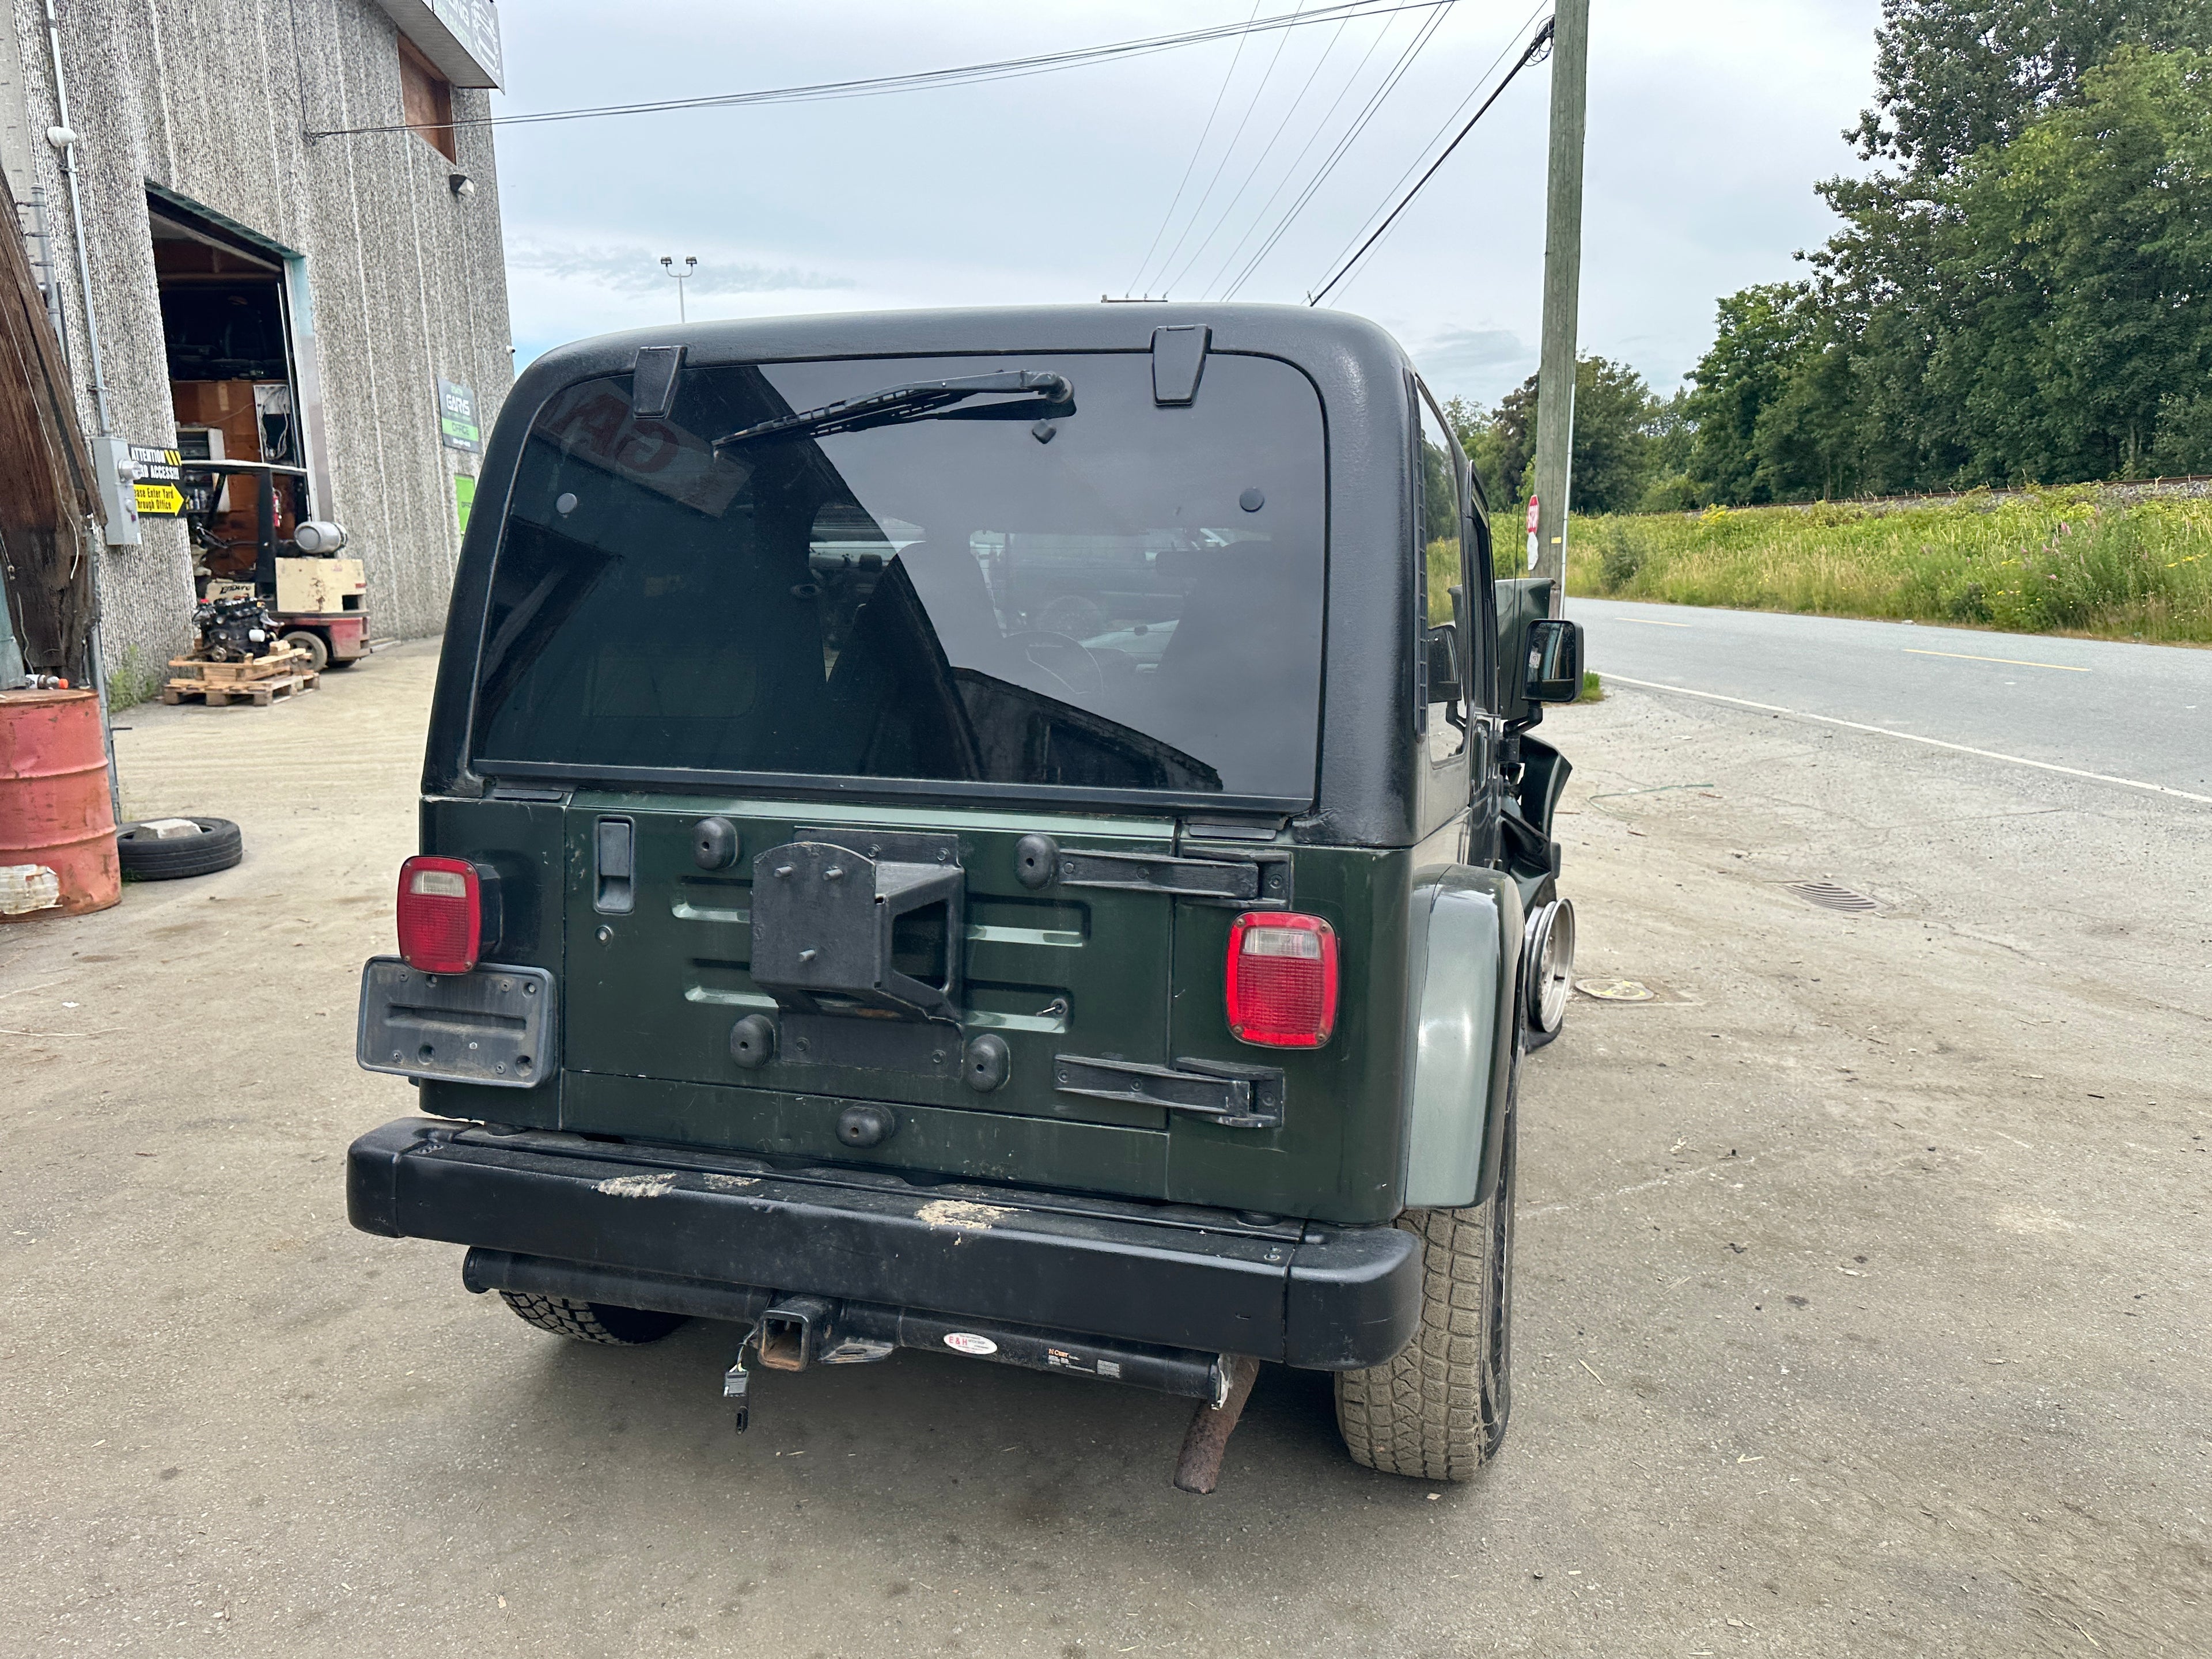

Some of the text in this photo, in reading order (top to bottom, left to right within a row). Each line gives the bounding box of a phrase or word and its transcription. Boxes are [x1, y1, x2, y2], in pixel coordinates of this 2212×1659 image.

[131, 447, 166, 464] ATTENTION
[147, 488, 161, 498] Enter
[162, 488, 174, 499] Yard
[156, 499, 172, 510] Office
[949, 1336, 953, 1344] E
[962, 1338, 967, 1346] H
